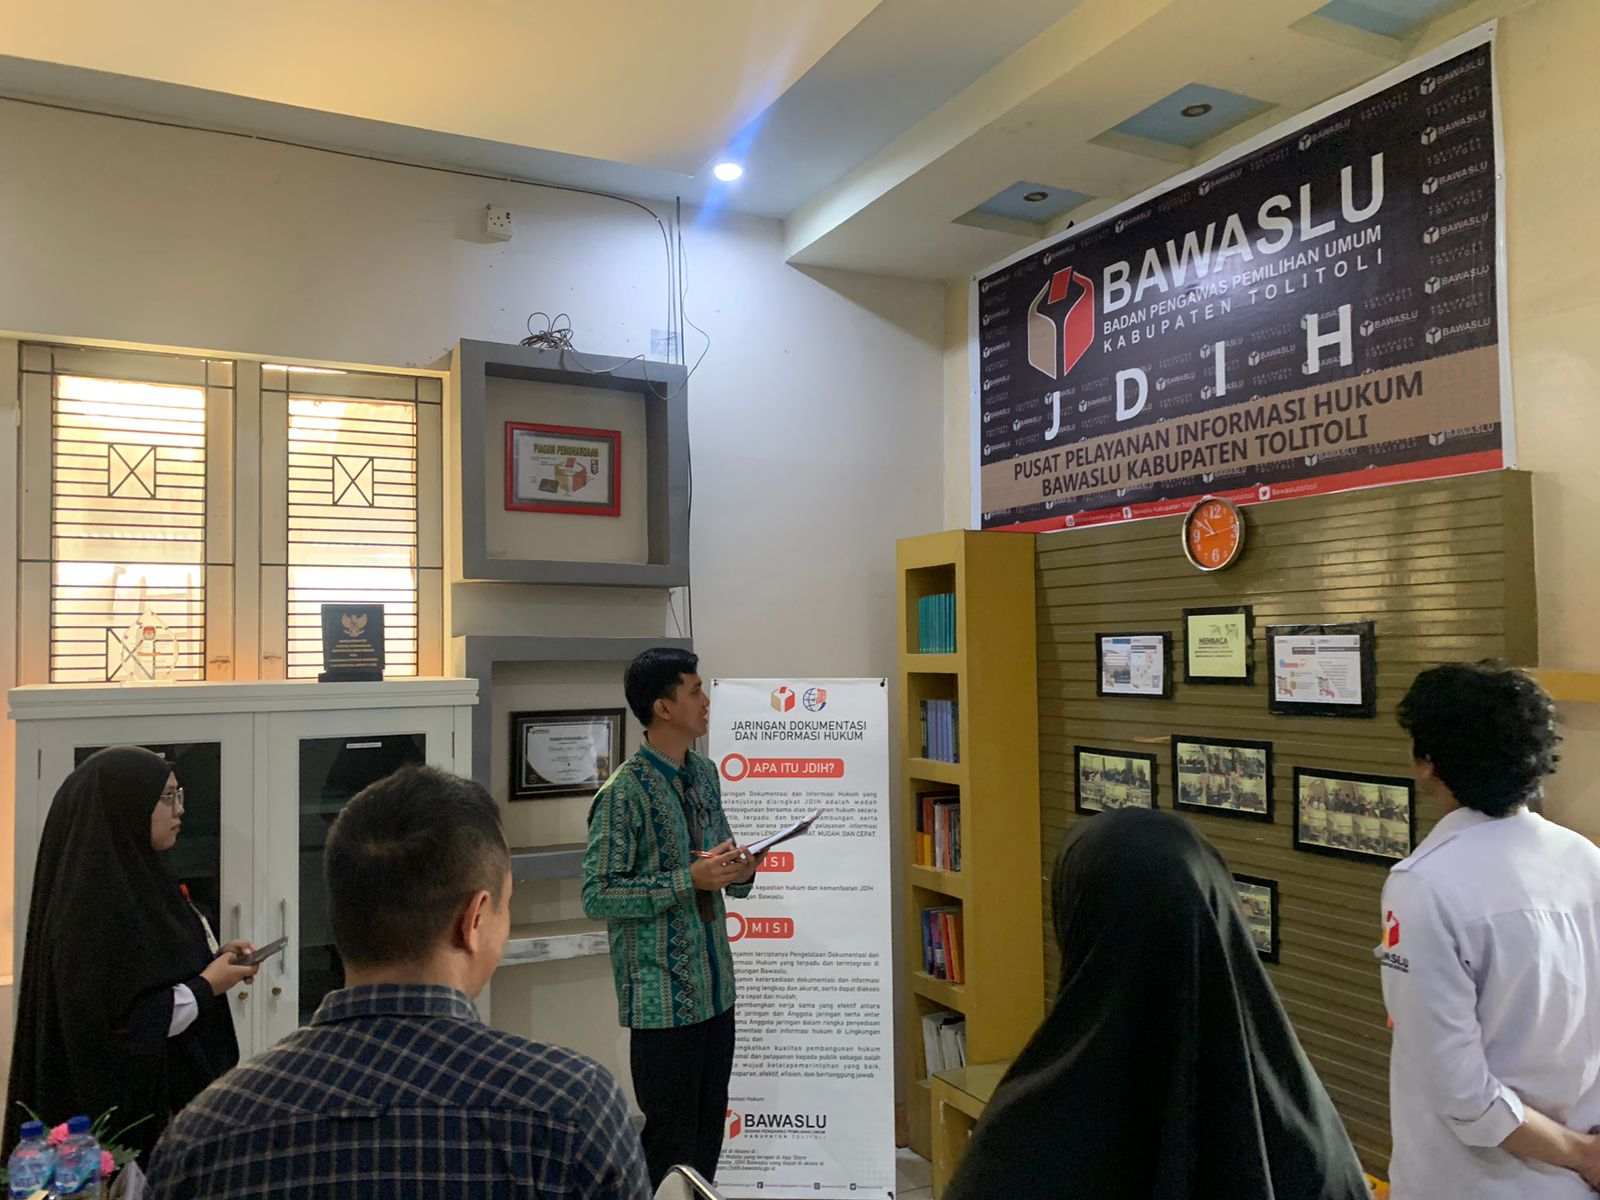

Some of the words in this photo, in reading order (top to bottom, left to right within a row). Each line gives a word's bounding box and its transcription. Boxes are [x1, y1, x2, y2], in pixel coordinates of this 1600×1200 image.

[1437, 109, 1487, 135] BAWASLU
[1439, 161, 1488, 184] BAWASLU
[1103, 152, 1384, 314] BAWASLU
[1440, 212, 1489, 235] BAWASLU
[1103, 308, 1147, 335] BADAN
[1150, 279, 1229, 318] PENGAWAS
[1232, 247, 1320, 288] PEMILIHAN
[1325, 224, 1382, 258] UMUM
[1441, 264, 1490, 286] BAWASLU
[1103, 299, 1232, 353] KABUPATEN
[1248, 248, 1382, 304] TOLITOLI
[1375, 310, 1419, 329] BAWASLU
[1442, 317, 1491, 337] BAWASLU
[1044, 390, 1061, 441] J
[1115, 368, 1149, 421] D
[1215, 340, 1227, 398] I
[1306, 303, 1353, 375] H
[1013, 454, 1061, 481] PUSAT
[1065, 428, 1170, 469] PELAYANAN
[1176, 397, 1307, 446] INFORMASI
[1314, 370, 1424, 418] HUKUM
[1042, 463, 1121, 497] BAWASLU
[1127, 438, 1249, 481] KABUPATEN
[1255, 413, 1369, 457] TOLITOLI
[1209, 504, 1221, 519] 12
[1212, 548, 1219, 562] 6
[731, 721, 786, 731] JARINGAN
[789, 721, 867, 731] DOKUMENTASI
[734, 731, 758, 740] DAN
[760, 731, 820, 740] INFORMASI
[824, 731, 863, 740] HUKUM
[753, 763, 777, 773] APA
[780, 763, 799, 773] ITU
[802, 763, 835, 773] JDIH?
[763, 857, 786, 866] ISI
[752, 923, 788, 933] MISI
[744, 1114, 827, 1128] BAWASLU
